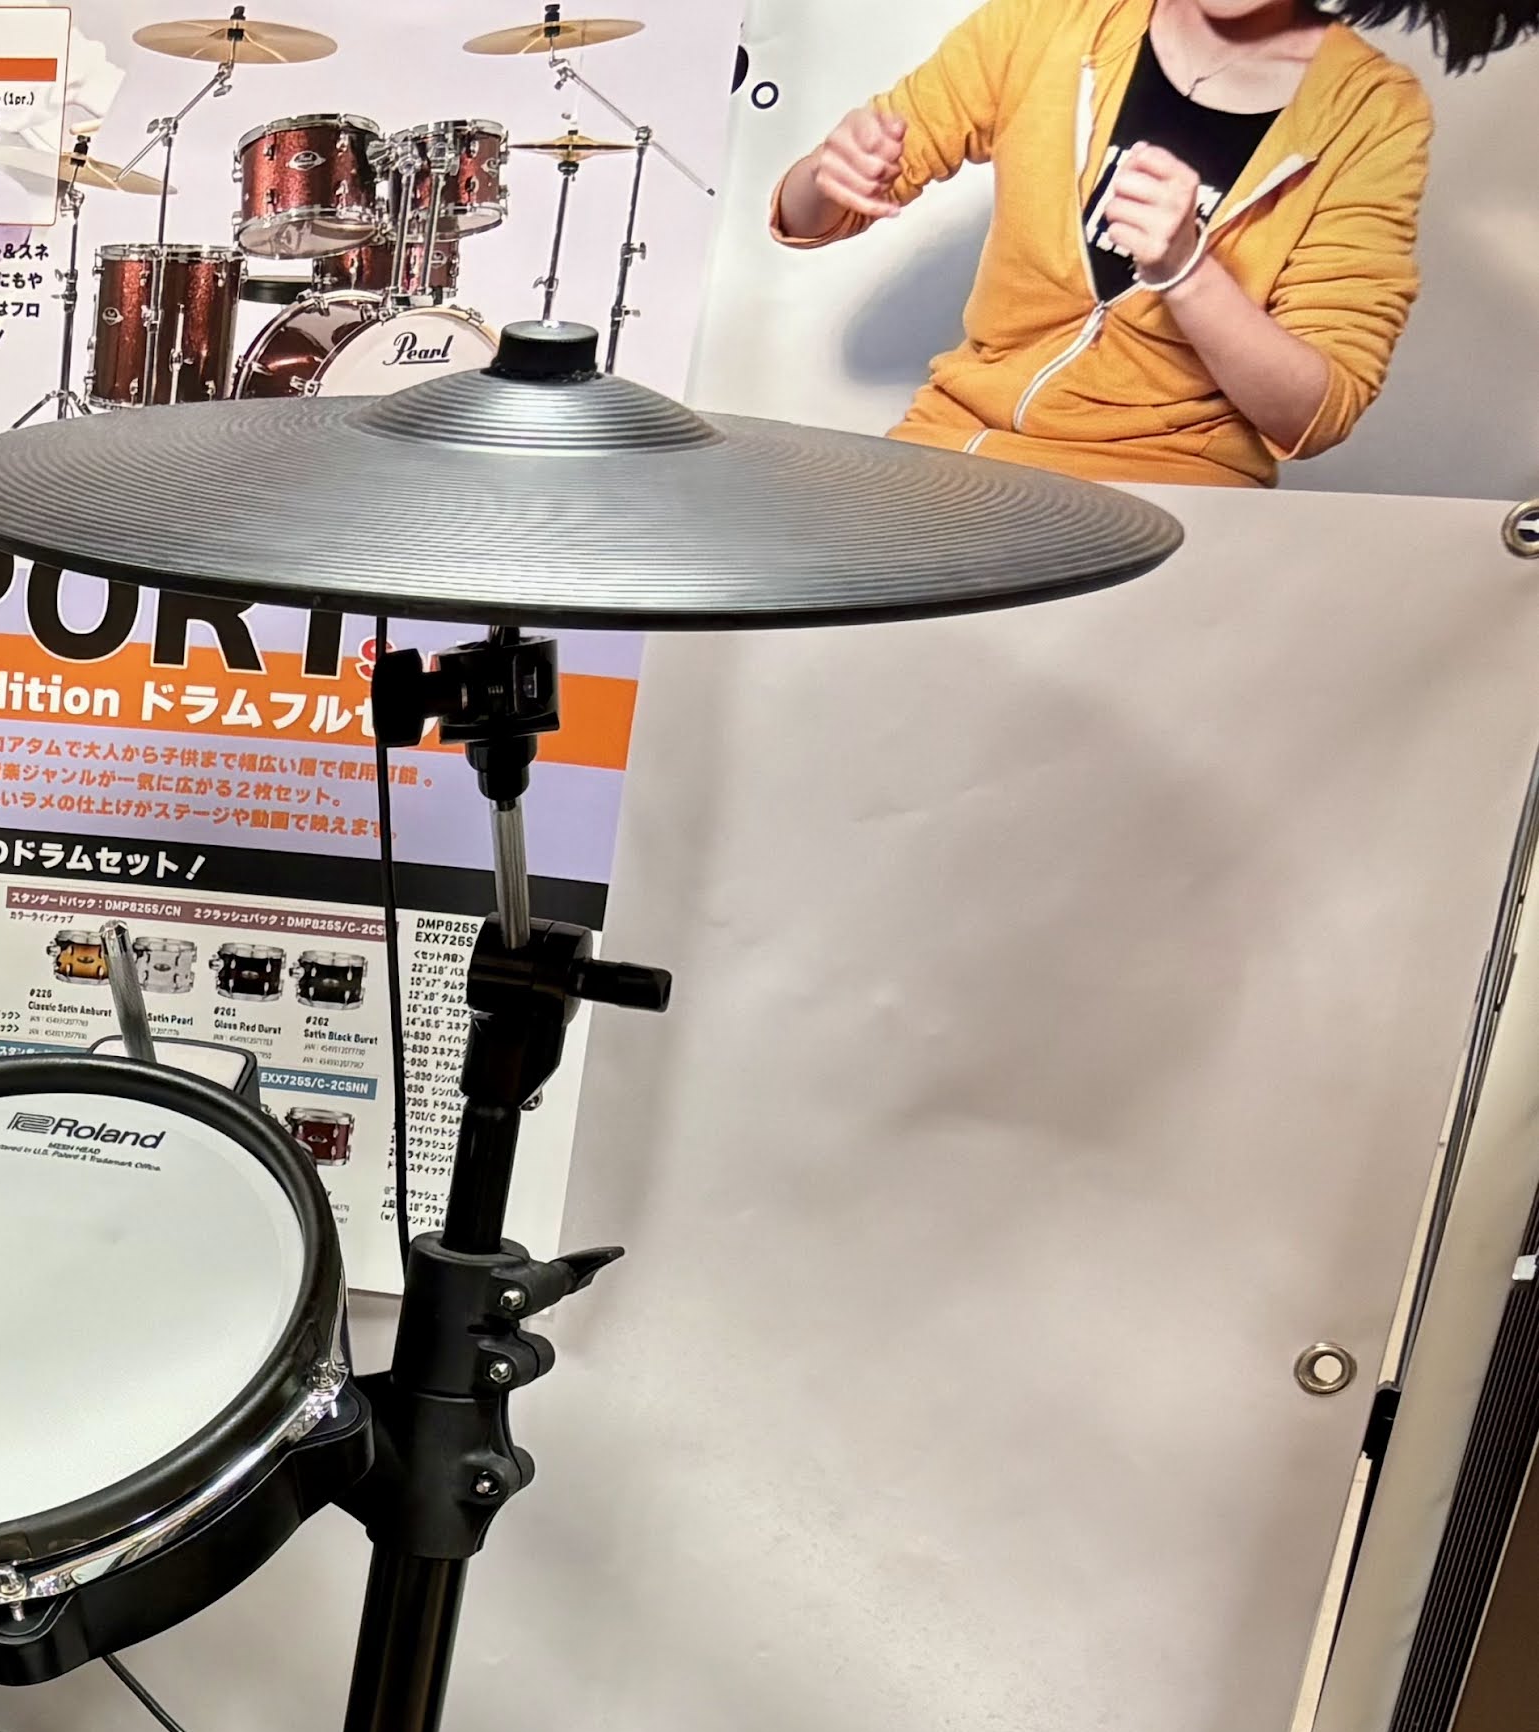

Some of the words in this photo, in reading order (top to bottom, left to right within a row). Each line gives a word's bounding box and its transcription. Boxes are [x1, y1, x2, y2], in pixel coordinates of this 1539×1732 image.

[383, 332, 453, 364] Pearl
[168, 1014, 194, 1027] Pearl
[237, 1021, 254, 1033] Red
[50, 1117, 167, 1149] Roland
